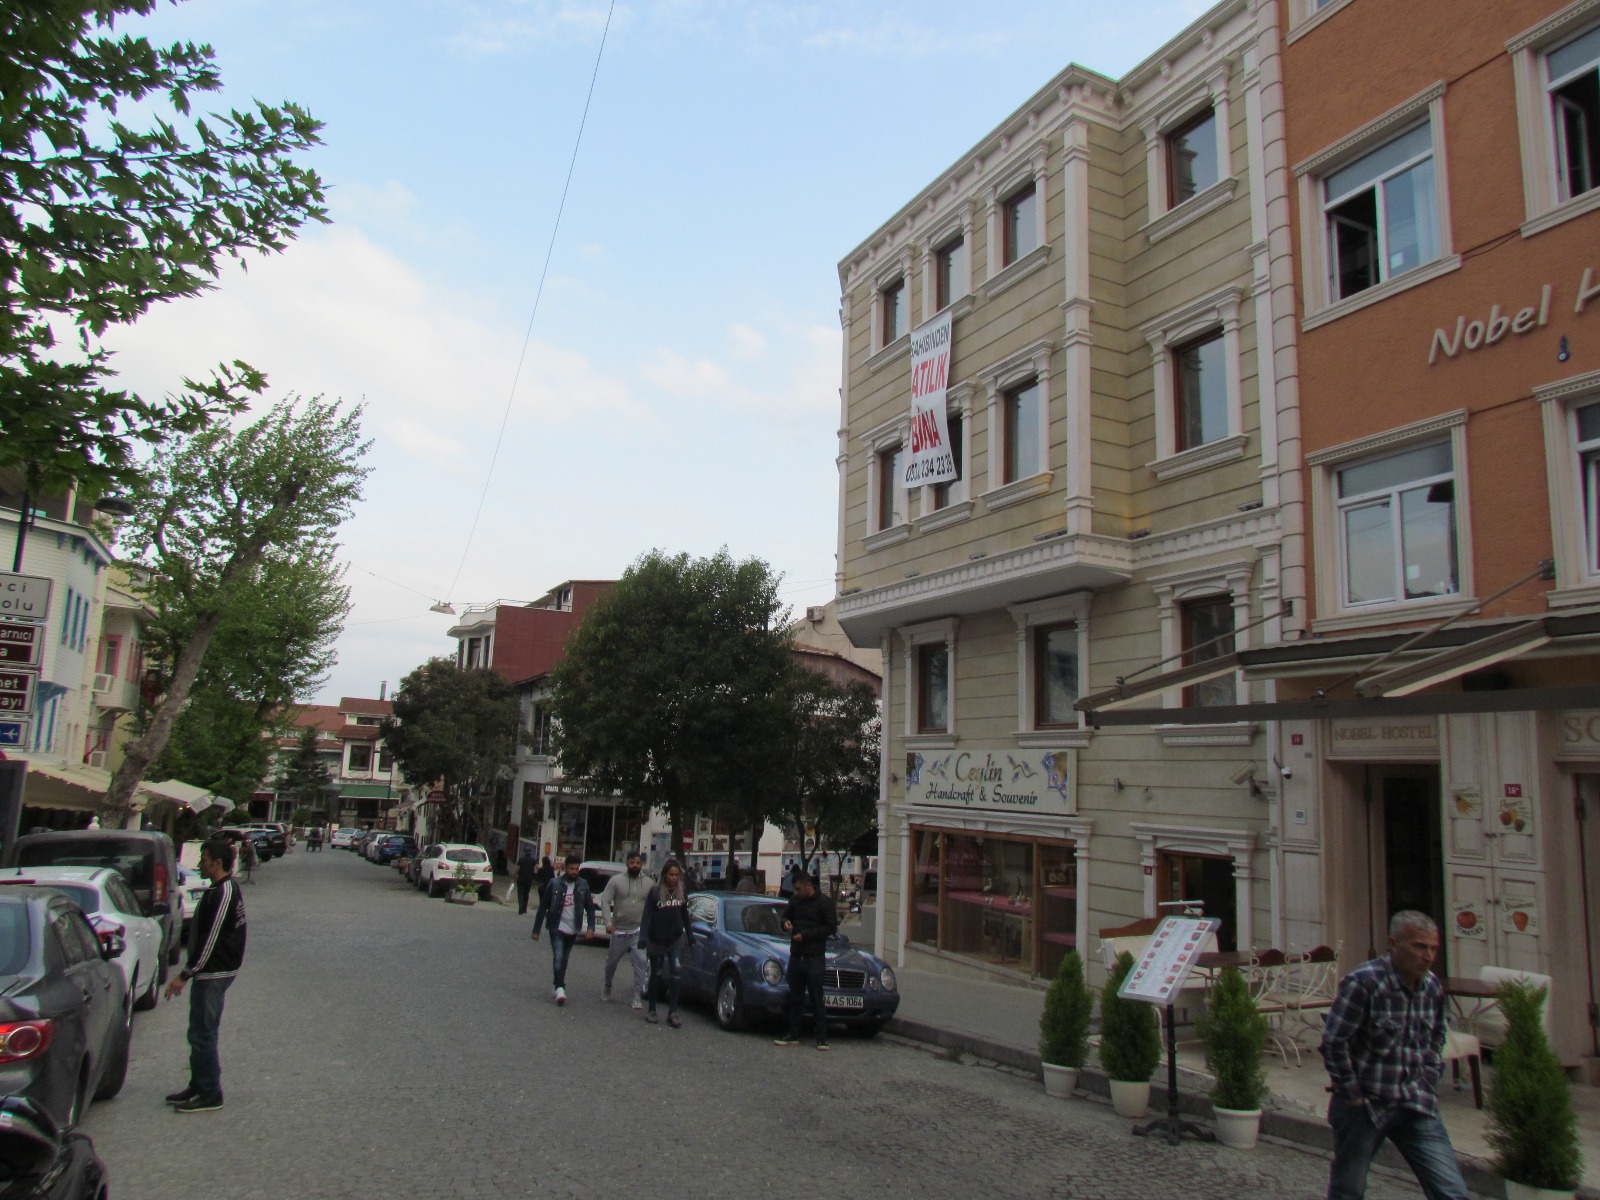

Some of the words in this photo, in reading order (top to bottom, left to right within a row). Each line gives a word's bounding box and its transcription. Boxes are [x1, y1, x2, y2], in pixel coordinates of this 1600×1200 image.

[1428, 284, 1551, 364] Nobel
[1333, 726, 1377, 741] NOBEL
[1382, 724, 1438, 740] HOSTEL
[955, 752, 1003, 789] Ceylin
[925, 782, 975, 805] Handcraft
[979, 786, 987, 801] &
[992, 784, 1038, 805] Souvenir
[832, 996, 845, 1006] AS
